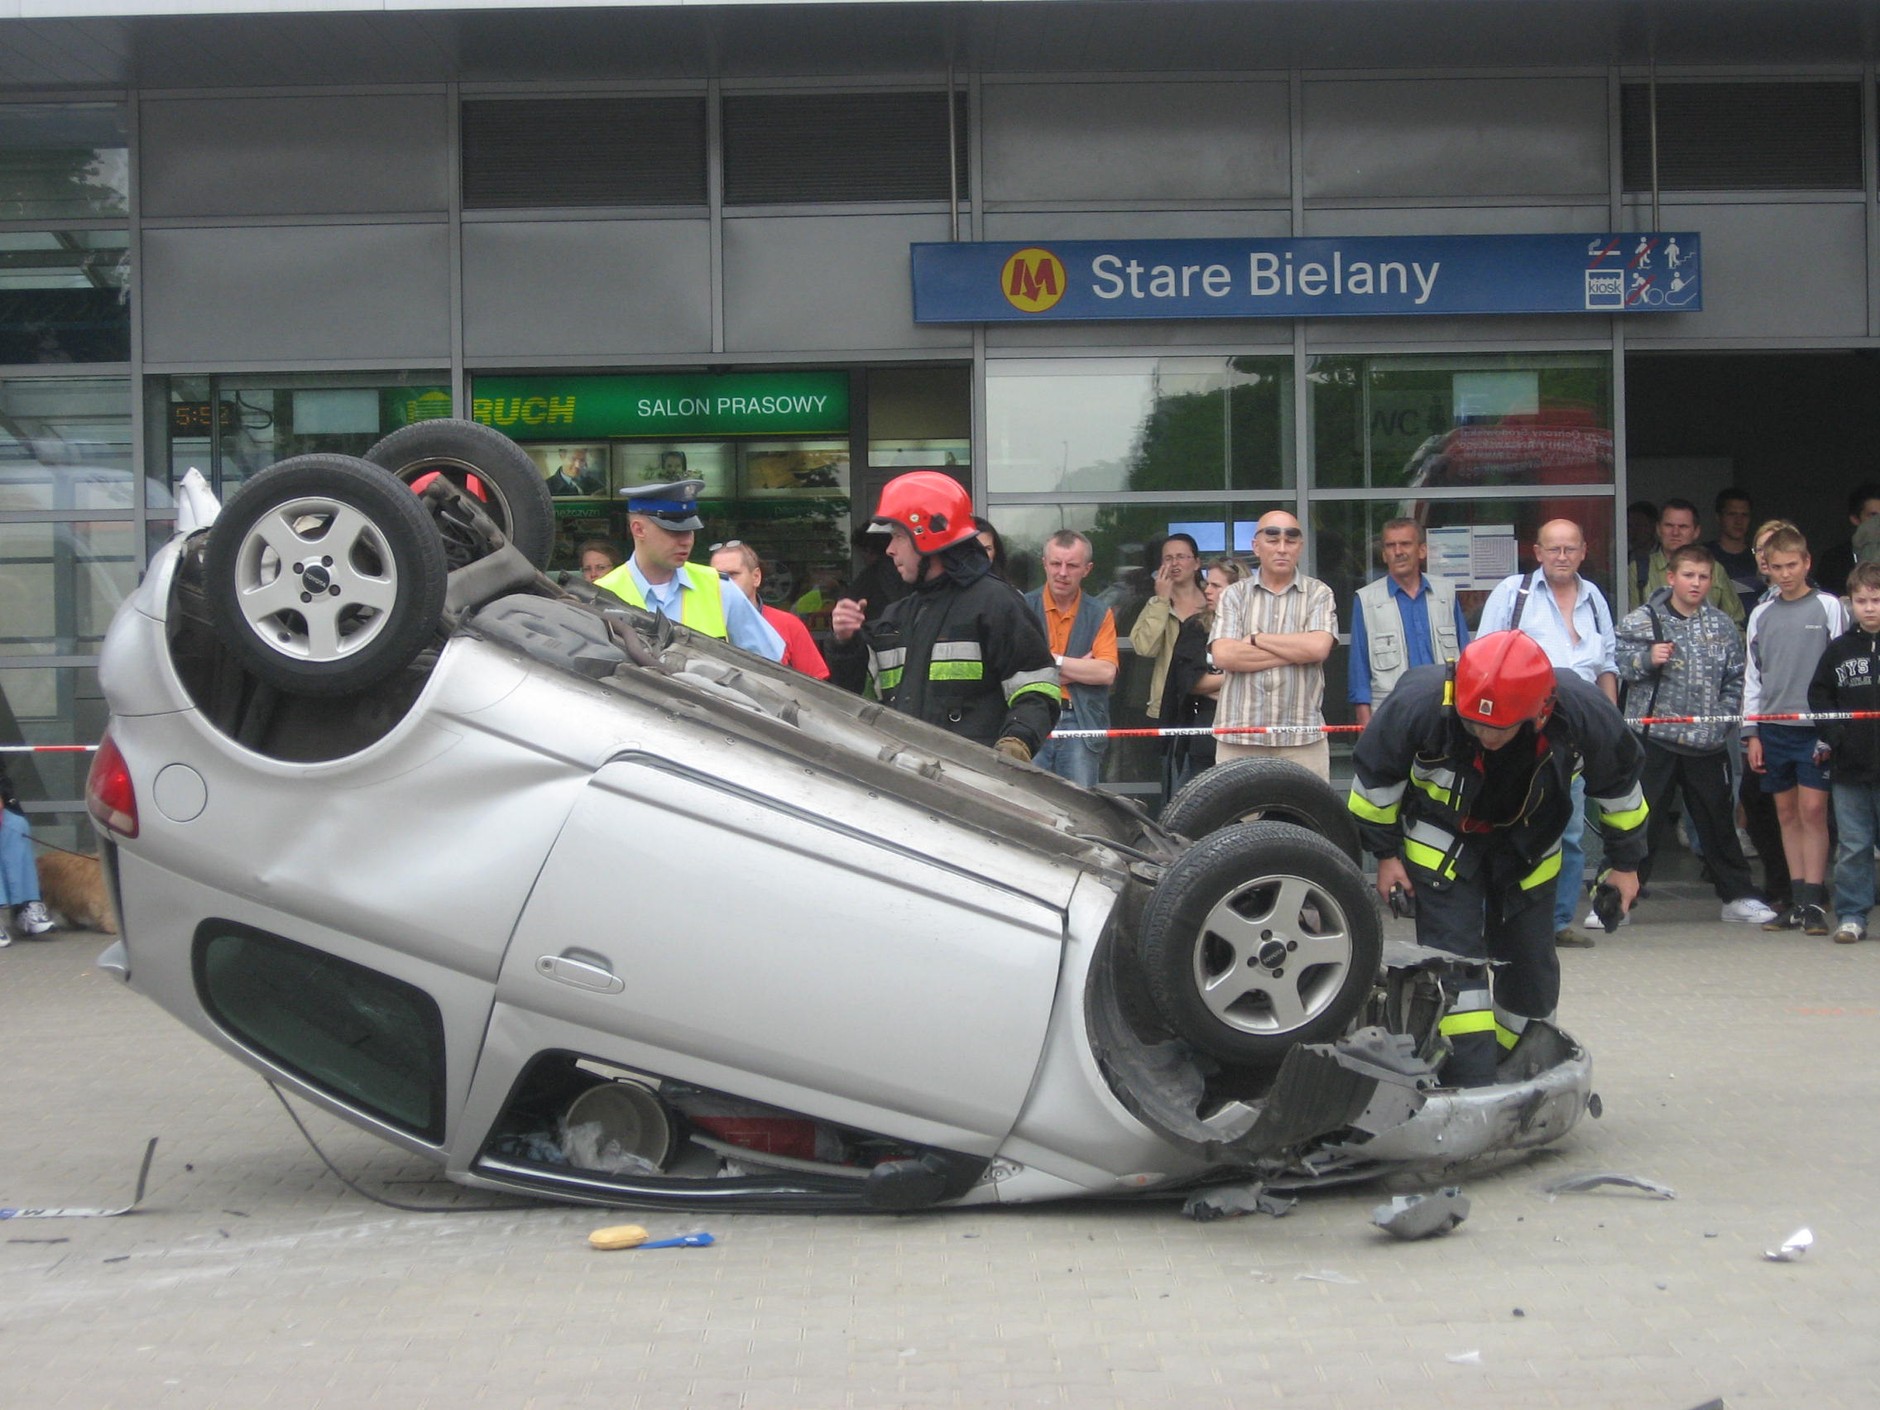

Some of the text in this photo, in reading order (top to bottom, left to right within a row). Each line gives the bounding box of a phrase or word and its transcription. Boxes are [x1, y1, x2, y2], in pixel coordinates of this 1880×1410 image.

[1091, 250, 1441, 305] Stare Bielany
[1588, 279, 1622, 293] kiosk
[472, 395, 576, 426] RUCH
[637, 395, 828, 417] SALON PRASOWY
[304, 571, 327, 588] TOYOTA
